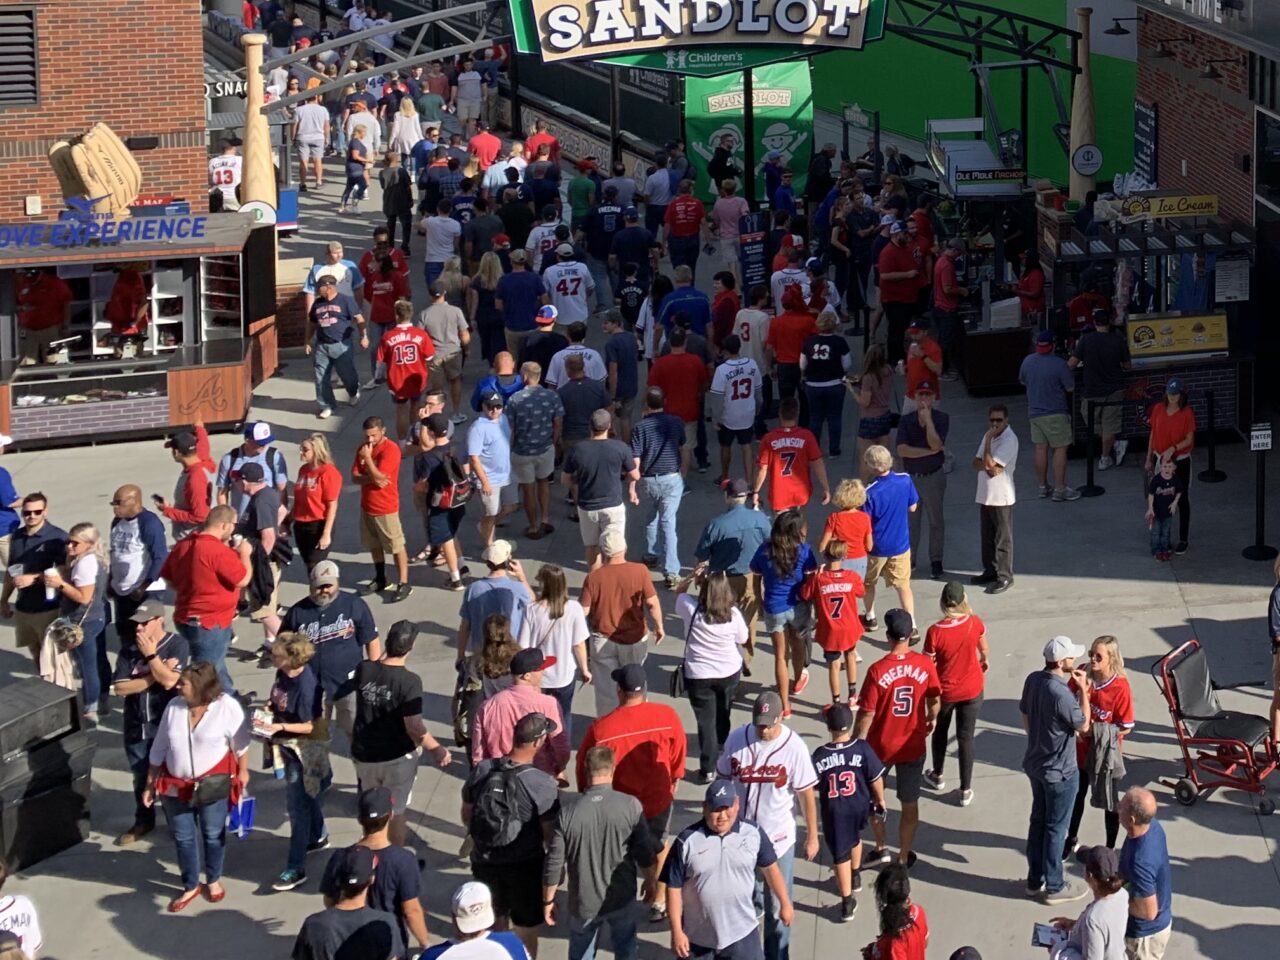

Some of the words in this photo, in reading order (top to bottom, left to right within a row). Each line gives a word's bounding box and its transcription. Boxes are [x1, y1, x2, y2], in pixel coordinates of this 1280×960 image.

[689, 52, 743, 64] Children's
[214, 169, 234, 185] 13
[1158, 200, 1176, 211] Ice
[1177, 197, 1216, 211] Cream
[50, 217, 208, 246] EXPERIENCE
[555, 278, 581, 297] 47
[739, 321, 750, 341] 3
[394, 344, 418, 365] 13
[810, 343, 831, 361] 13
[731, 378, 752, 401] 13
[770, 437, 805, 451] SWANSON
[1251, 433, 1272, 441] ENTER
[1252, 441, 1270, 450] HERE
[780, 451, 796, 477] 7
[830, 596, 846, 619] 7
[878, 664, 929, 690] FREEMAN
[892, 685, 914, 717] 5
[815, 752, 846, 774] ACUÑA
[827, 770, 857, 799] 13
